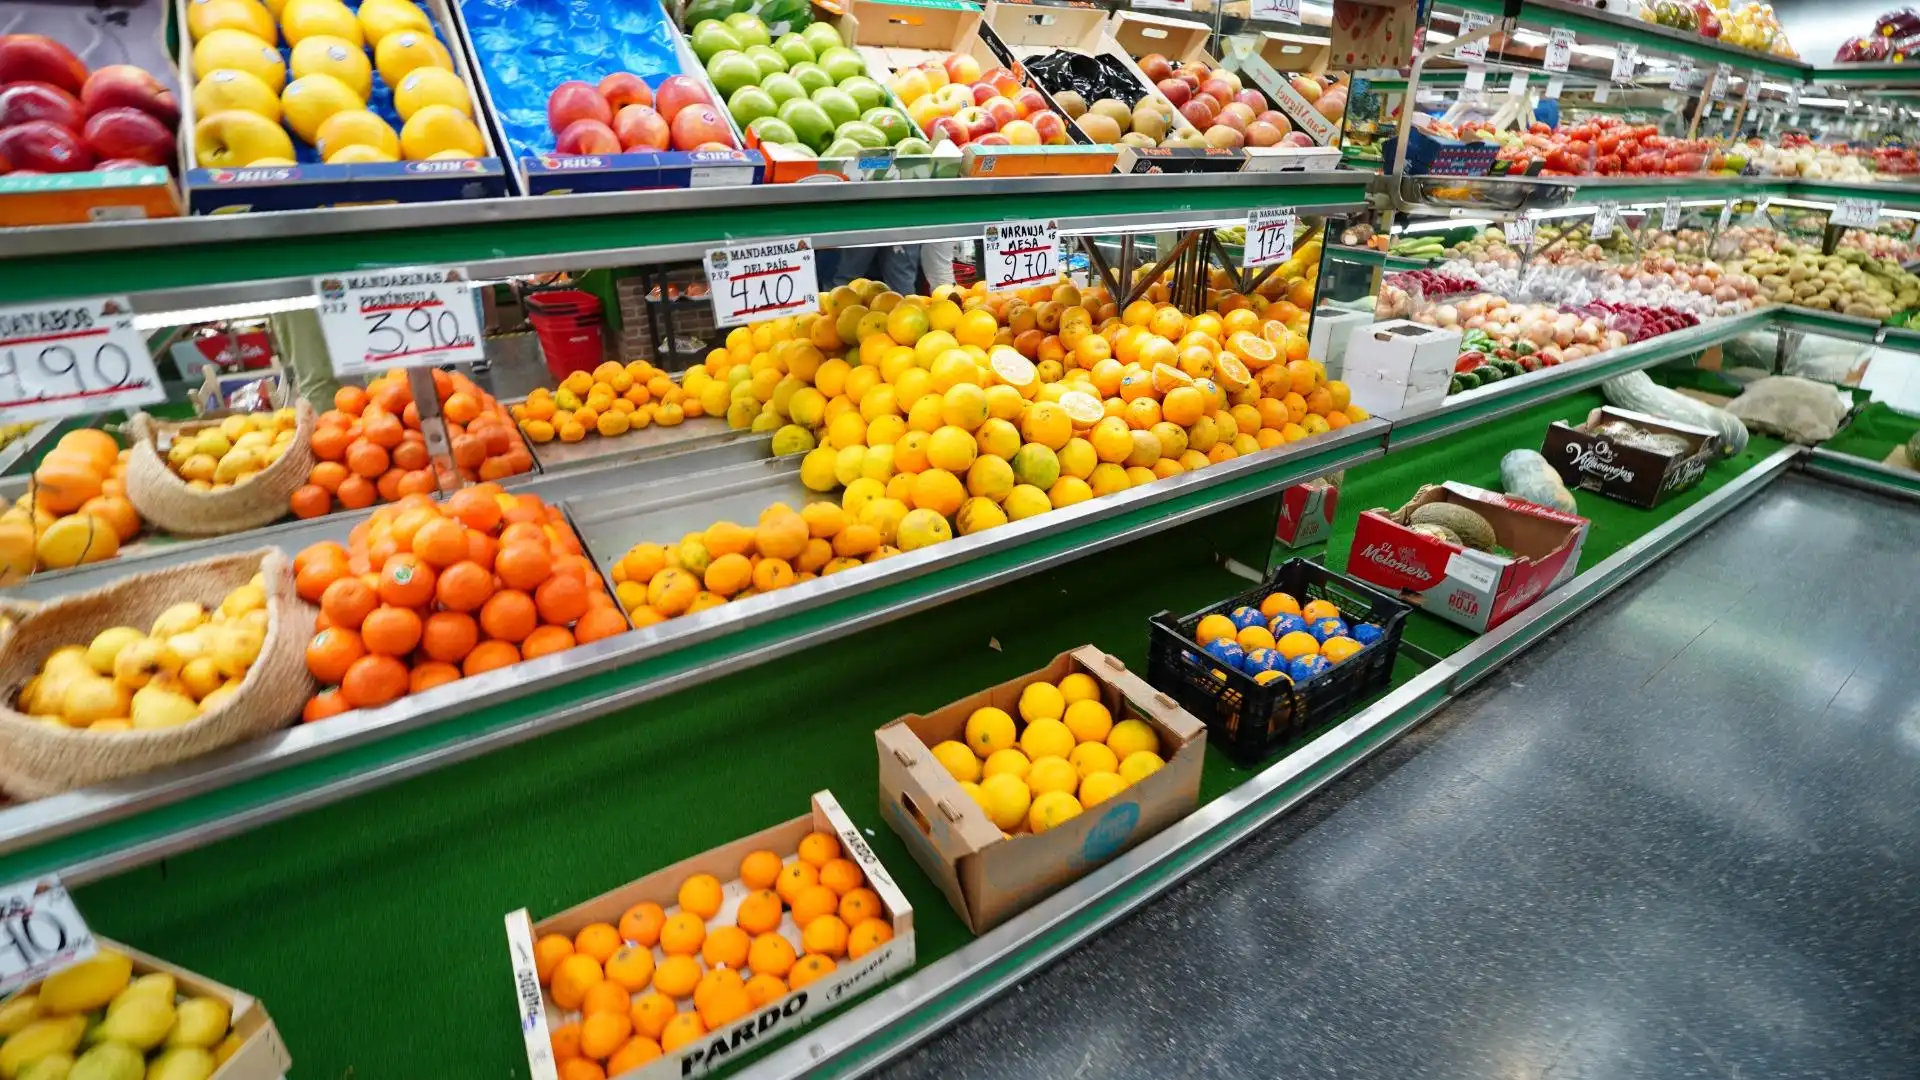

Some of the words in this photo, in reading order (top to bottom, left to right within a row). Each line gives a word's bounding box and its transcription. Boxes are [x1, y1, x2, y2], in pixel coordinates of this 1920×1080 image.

[562, 156, 602, 168] RIUS
[1260, 209, 1288, 218] NARANJAS
[1001, 225, 1045, 239] NARANJA
[730, 243, 797, 261] MANDARINAS
[1009, 238, 1039, 252] MESA
[744, 263, 764, 276] DEL
[347, 272, 443, 289] MANDARINAS
[1360, 544, 1433, 581] Melonero
[681, 991, 809, 1077] PARDO
